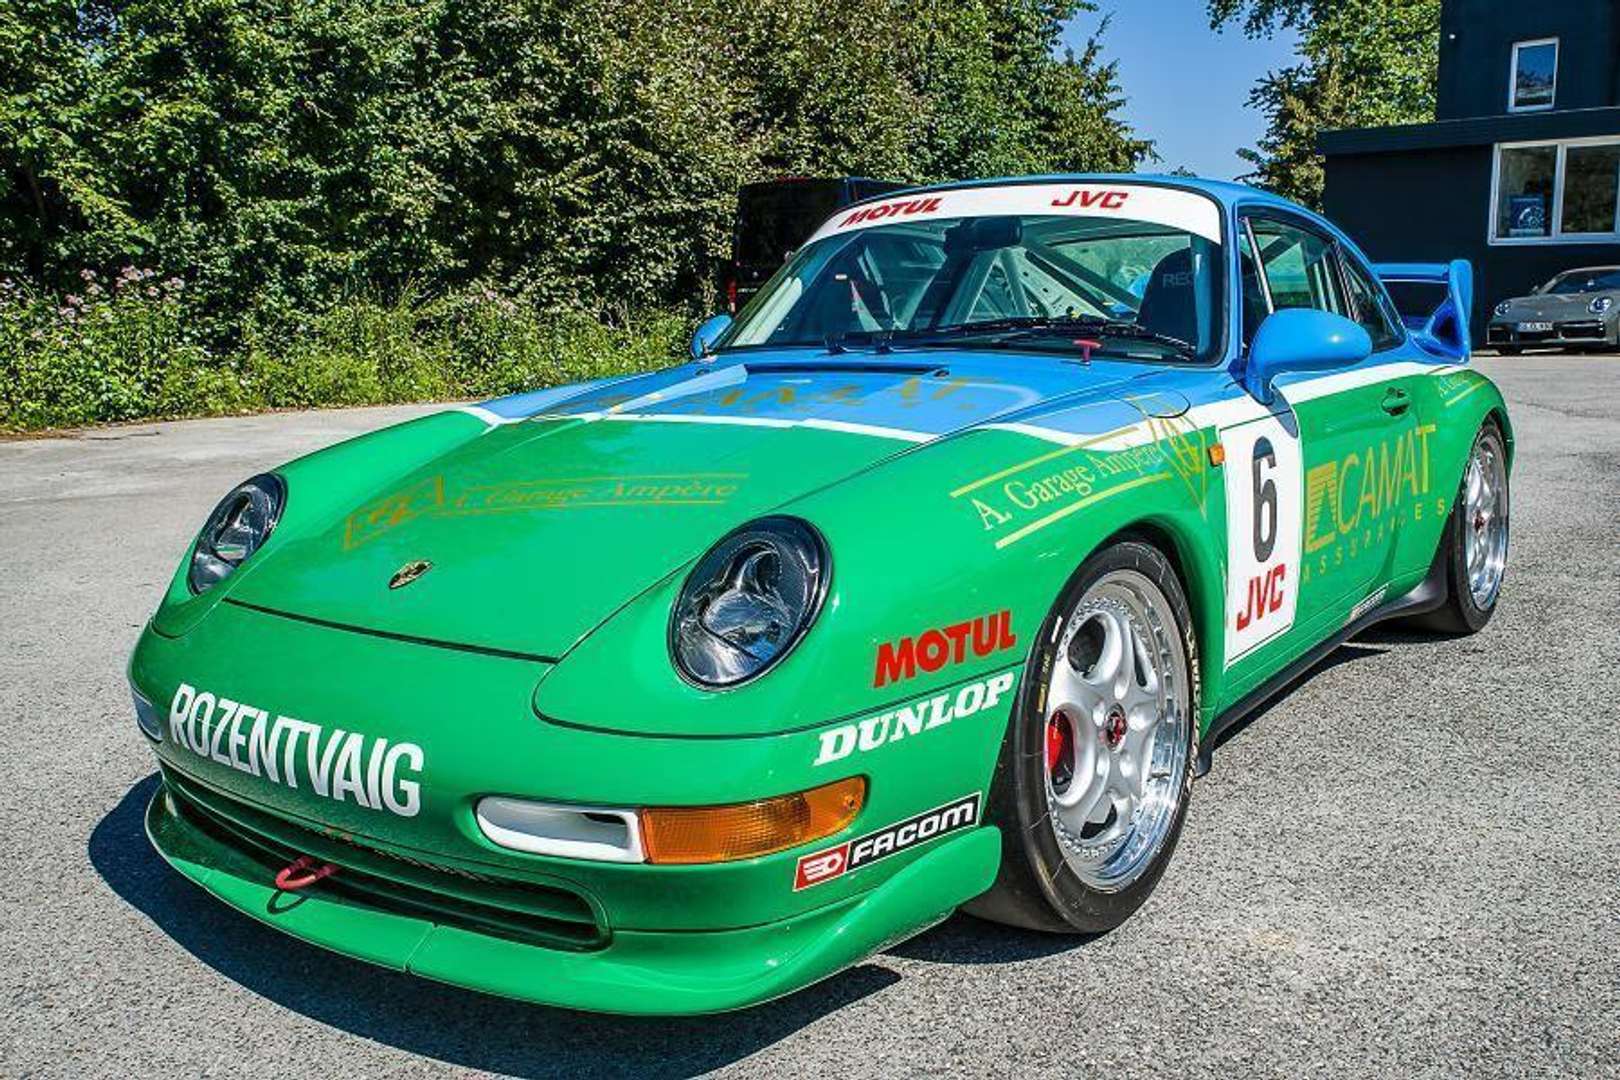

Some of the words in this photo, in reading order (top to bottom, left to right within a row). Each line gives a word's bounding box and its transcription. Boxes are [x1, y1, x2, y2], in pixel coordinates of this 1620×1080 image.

[838, 198, 943, 228] MOTUL
[1051, 191, 1128, 208] JVC
[1004, 466, 1095, 510] Garage
[1252, 436, 1277, 563] 6
[1337, 425, 1436, 533] CAMAT
[1237, 564, 1286, 632] JVC
[874, 610, 1016, 688] MOTUL
[169, 683, 424, 817] ROZENTVAIG
[813, 672, 1014, 766] DUNLOP
[852, 802, 974, 865] FACOM
